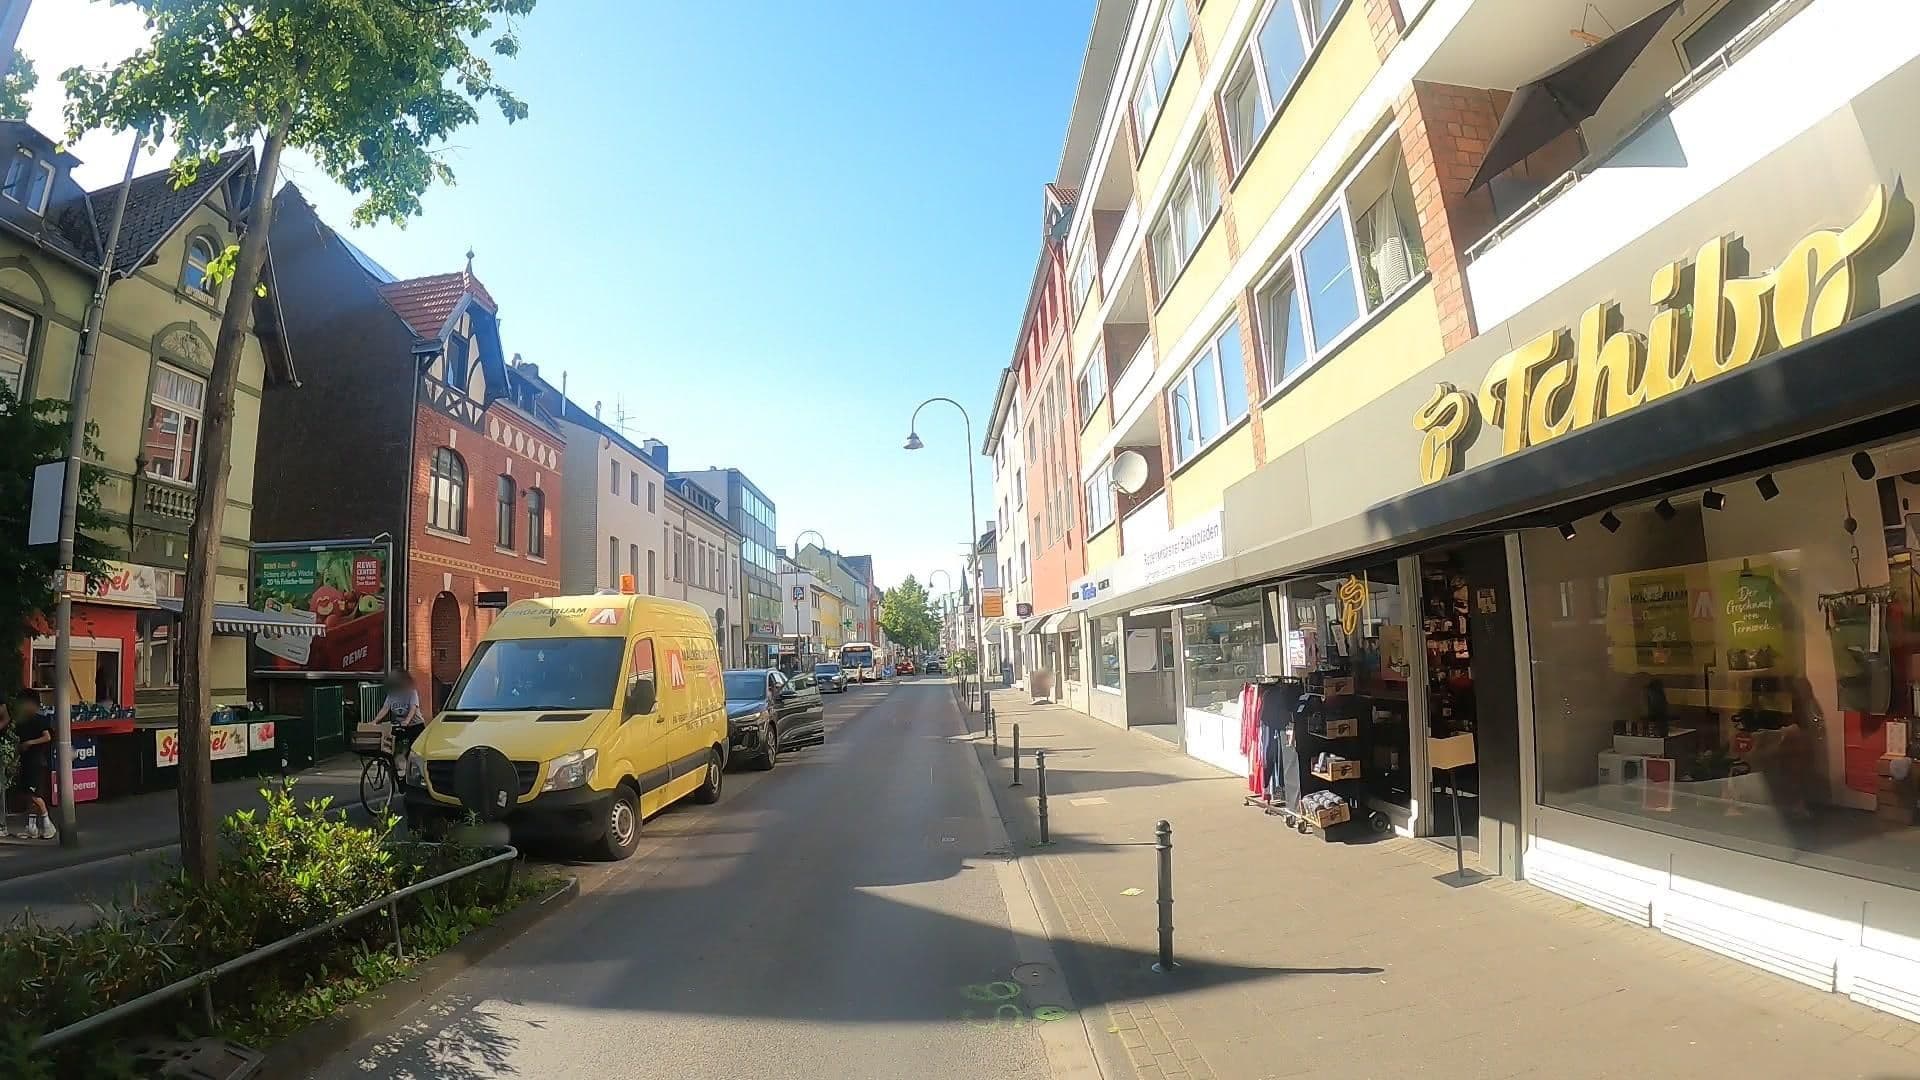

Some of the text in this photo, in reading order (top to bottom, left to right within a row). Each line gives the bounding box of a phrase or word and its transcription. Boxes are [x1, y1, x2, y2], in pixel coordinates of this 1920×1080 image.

[1480, 184, 1887, 457] Tchibo
[357, 560, 377, 569] REWE
[342, 645, 369, 668] REWE
